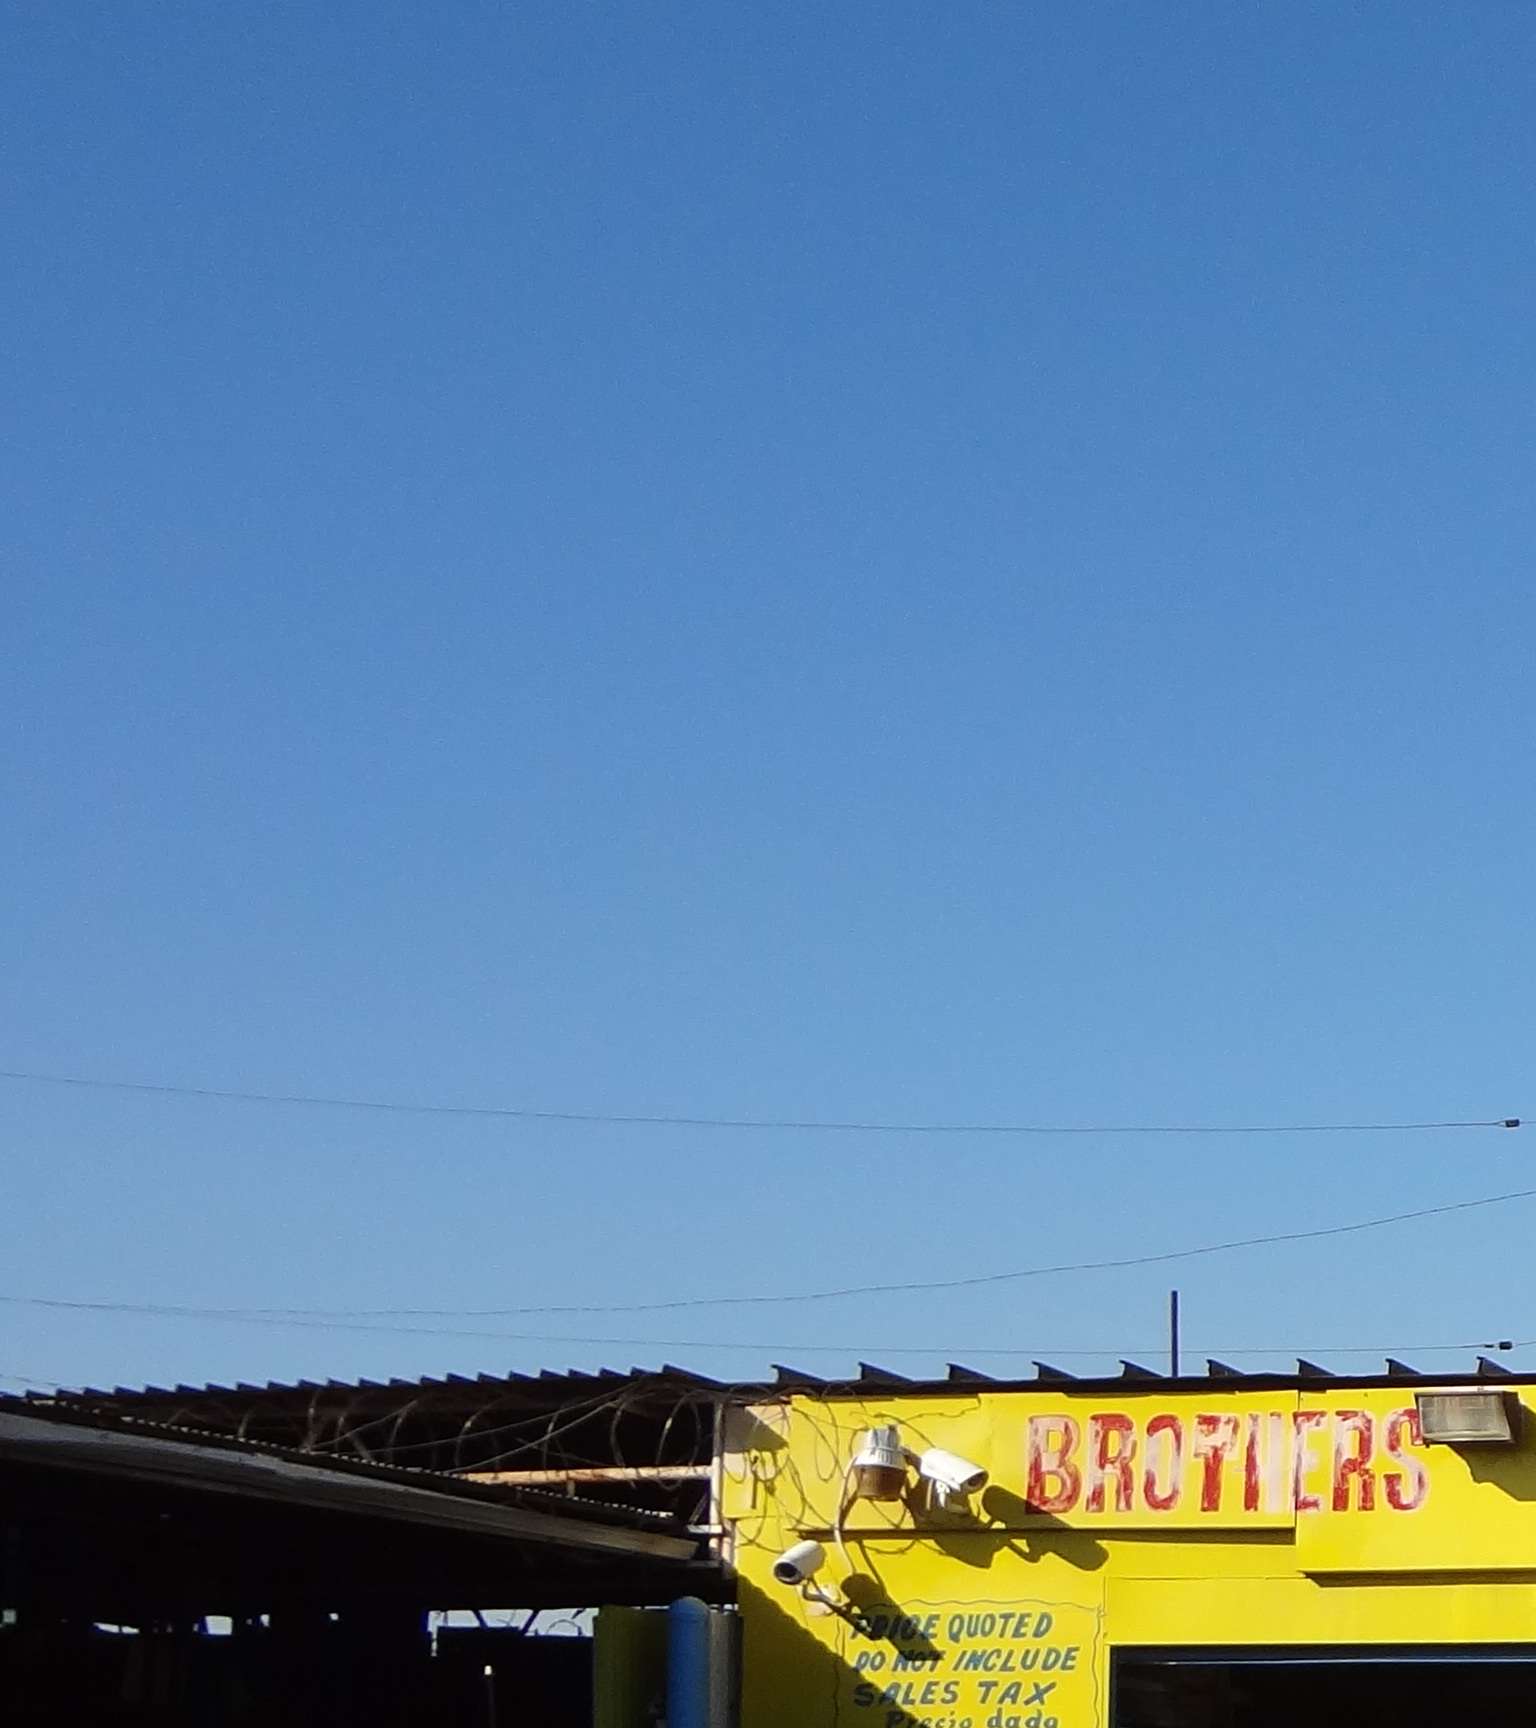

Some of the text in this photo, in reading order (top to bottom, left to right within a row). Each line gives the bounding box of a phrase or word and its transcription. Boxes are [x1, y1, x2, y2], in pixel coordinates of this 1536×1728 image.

[1024, 1409, 1430, 1514] BROTHERS
[947, 1611, 1052, 1643] QUOTED
[854, 1646, 1080, 1673] DO NOT INCLUDE
[854, 1680, 1057, 1707] SALES TAX
